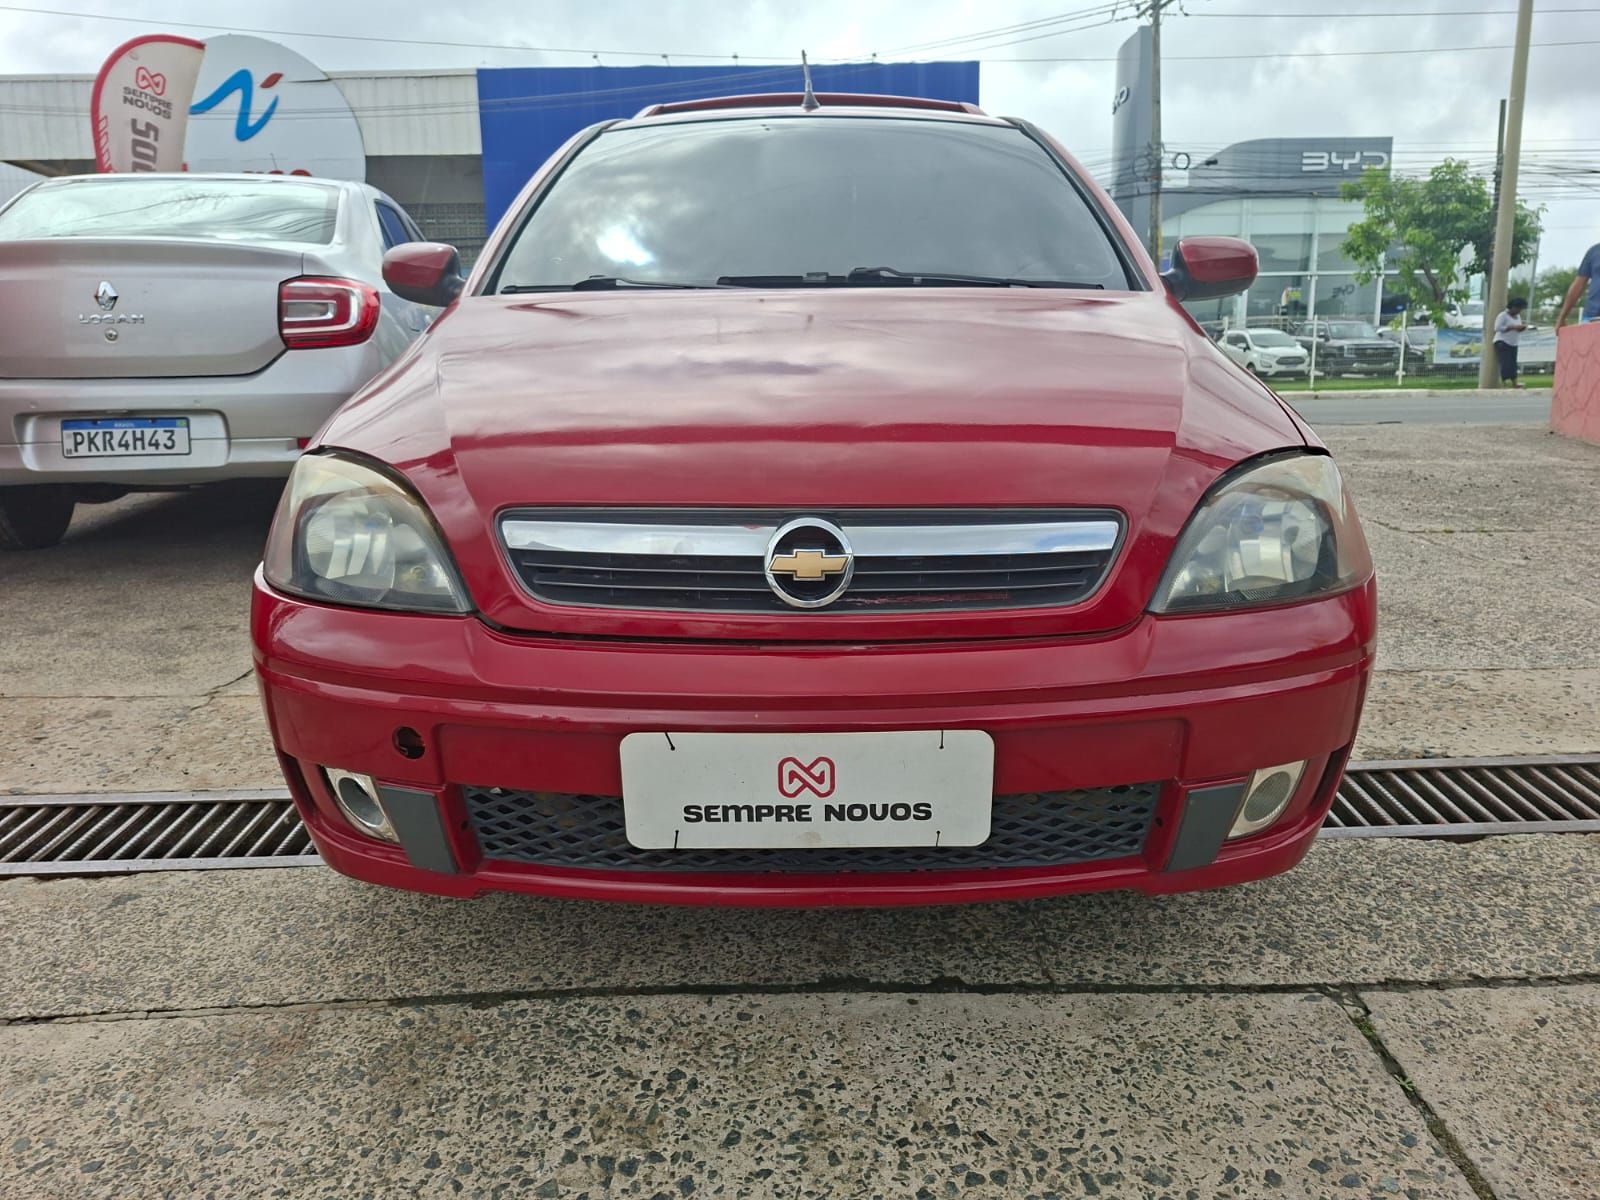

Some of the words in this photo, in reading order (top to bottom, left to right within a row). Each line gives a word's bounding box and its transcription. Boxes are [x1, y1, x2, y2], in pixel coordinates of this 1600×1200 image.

[123, 86, 172, 111] SEMPRE
[1302, 152, 1388, 171] BYD
[79, 313, 145, 324] LOGAN
[72, 430, 176, 453] PKR4H43
[683, 804, 812, 823] SEMPRE
